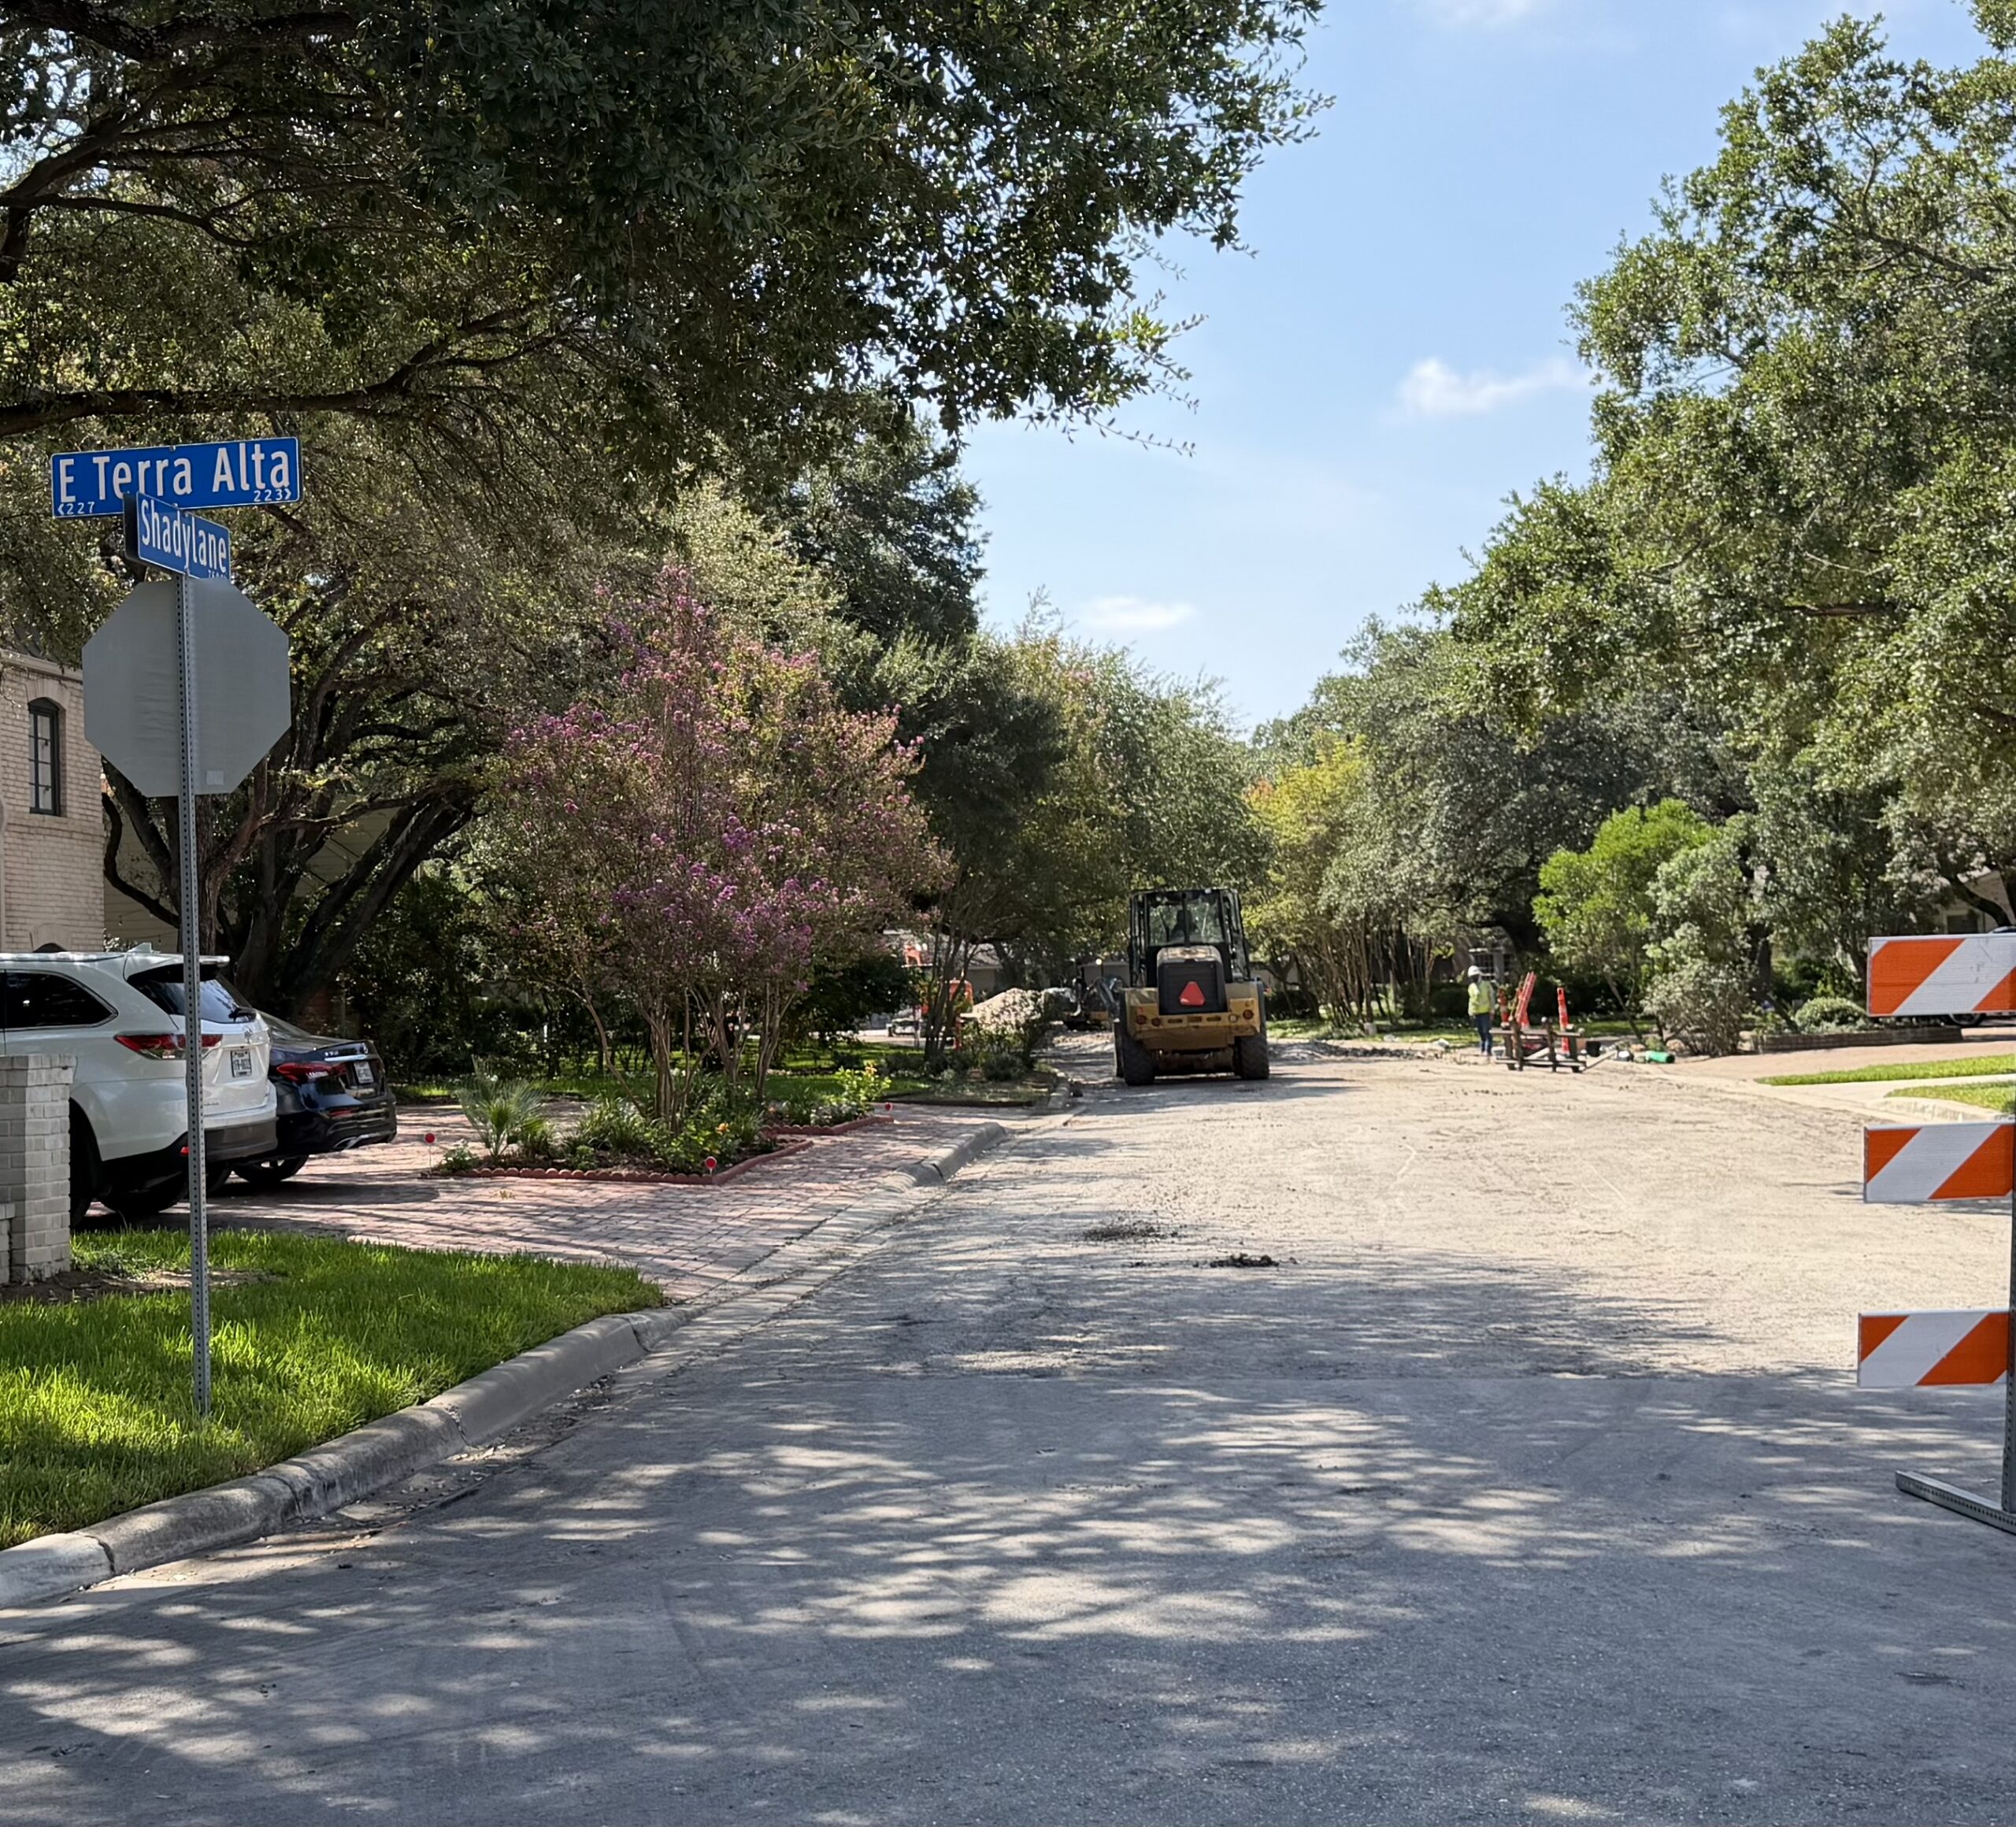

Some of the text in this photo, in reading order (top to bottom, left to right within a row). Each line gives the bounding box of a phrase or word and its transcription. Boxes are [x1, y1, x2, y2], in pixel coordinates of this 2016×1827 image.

[60, 443, 290, 502] E Terra Alta
[66, 502, 94, 514] 227
[254, 489, 283, 502] 223
[141, 498, 226, 573] Shadylane
